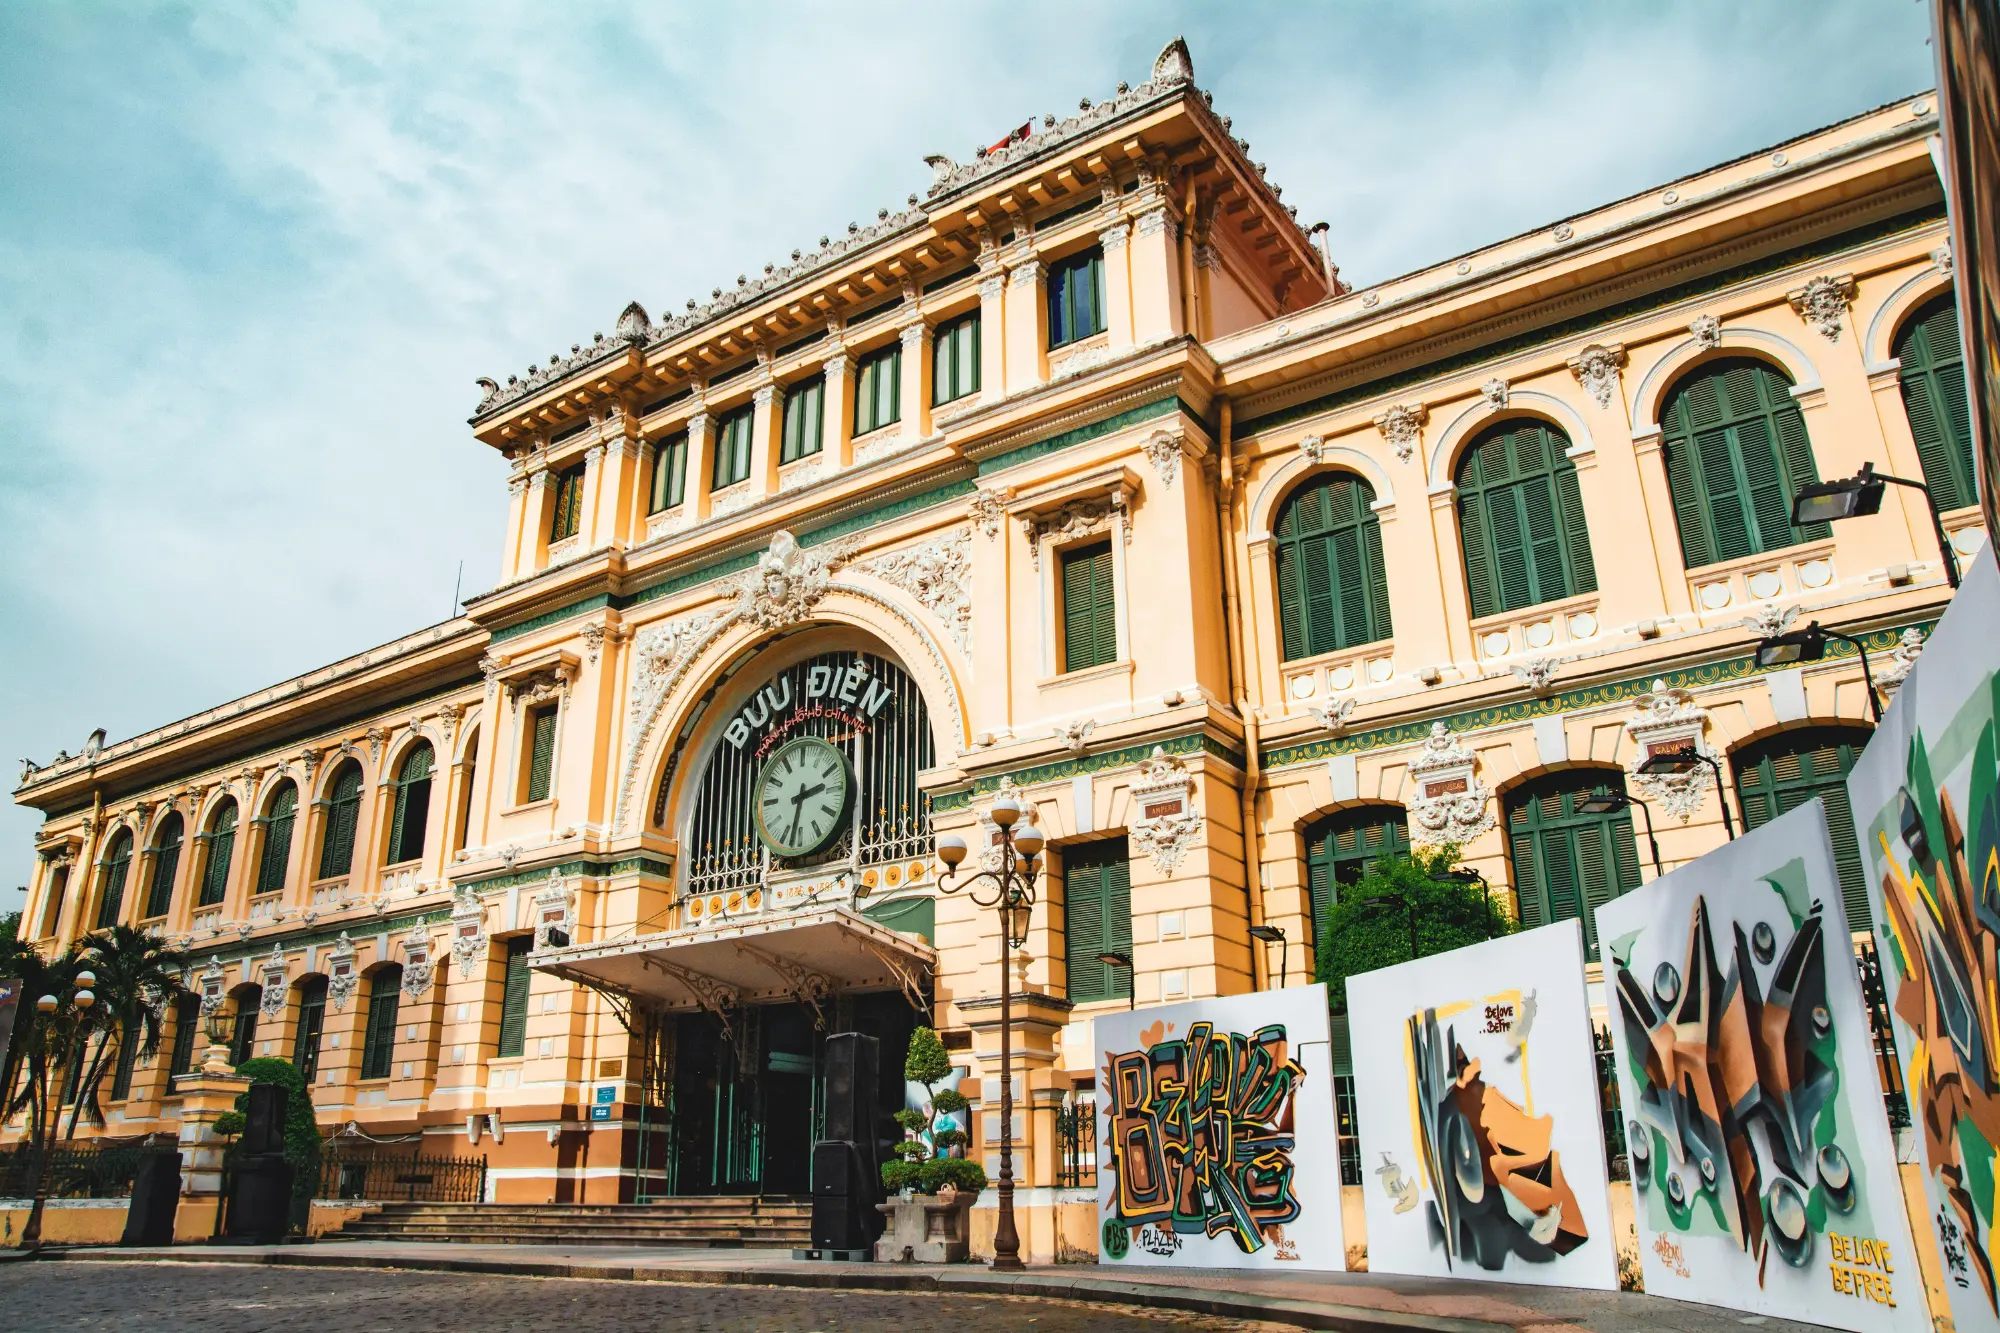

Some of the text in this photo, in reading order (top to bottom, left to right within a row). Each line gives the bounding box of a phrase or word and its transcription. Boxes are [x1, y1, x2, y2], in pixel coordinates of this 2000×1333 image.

[808, 660, 892, 718] ĐIỆN
[785, 706, 804, 729] PHỐ
[842, 713, 866, 732] MINH
